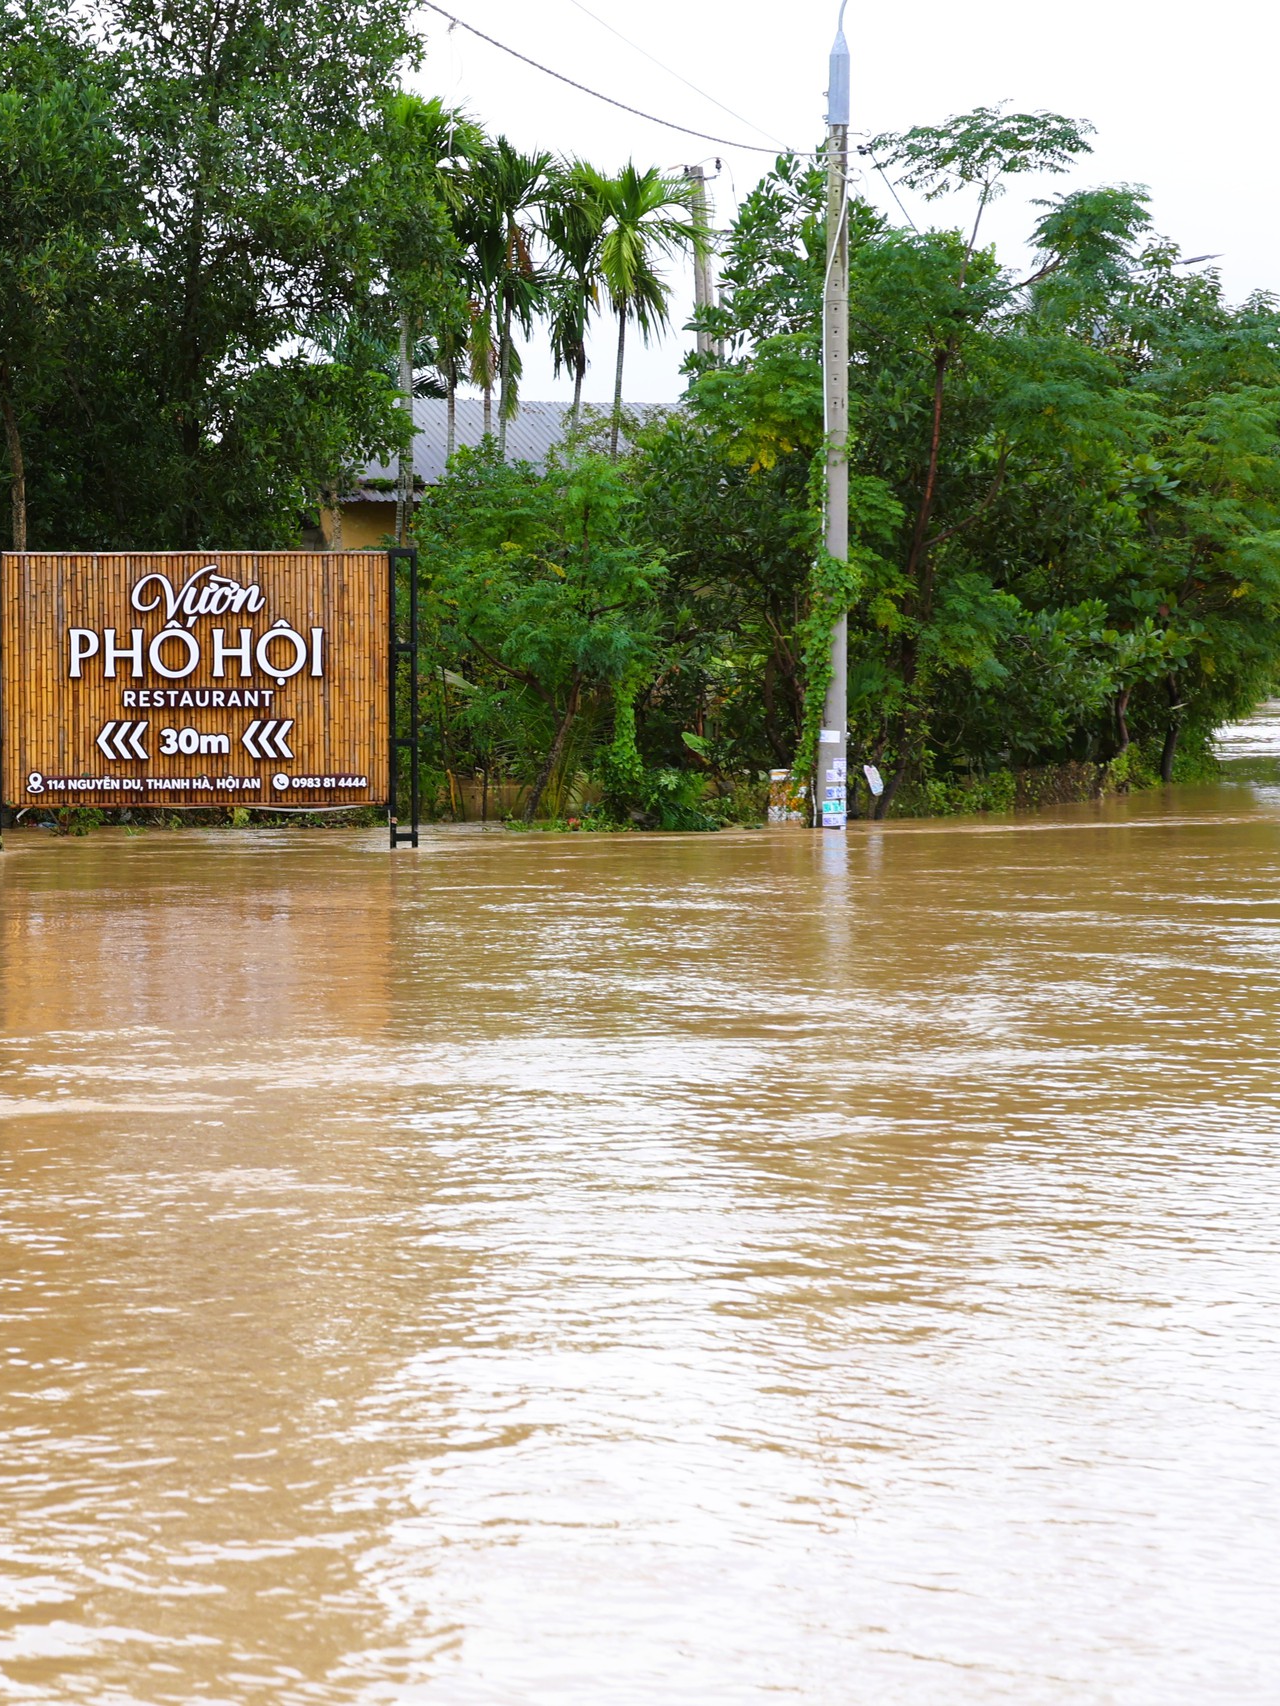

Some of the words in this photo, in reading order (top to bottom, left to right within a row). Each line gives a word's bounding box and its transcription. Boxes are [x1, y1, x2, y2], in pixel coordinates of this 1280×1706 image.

[131, 564, 266, 620] Vườn
[68, 616, 200, 679] PHỐ
[212, 618, 324, 686] HỘI
[123, 690, 274, 707] RESTAURANT
[159, 727, 230, 755] 30m
[46, 779, 66, 790] 114
[67, 775, 120, 790] NGUYỄN
[122, 779, 144, 791] DU,
[146, 778, 190, 789] THANH
[192, 775, 214, 791] HÀ,
[216, 775, 240, 793] HỘI
[242, 778, 261, 789] AN
[291, 777, 321, 788] 0983
[323, 777, 336, 788] 81
[338, 777, 367, 788] 4444
